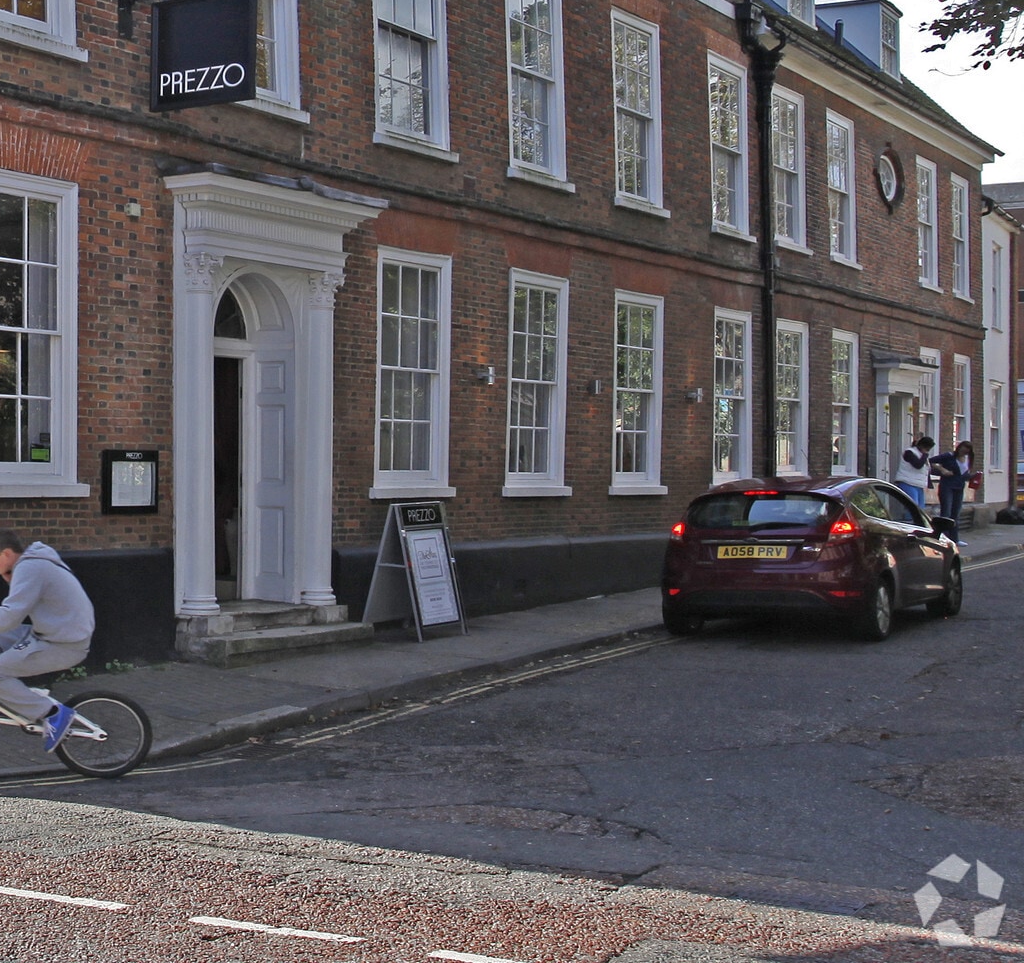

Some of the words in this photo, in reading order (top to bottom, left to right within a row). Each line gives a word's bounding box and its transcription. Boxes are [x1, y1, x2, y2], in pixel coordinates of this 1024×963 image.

[159, 62, 245, 97] PREZZO
[407, 508, 436, 523] PREZZO
[723, 546, 755, 557] AO58
[758, 546, 784, 557] PRV
